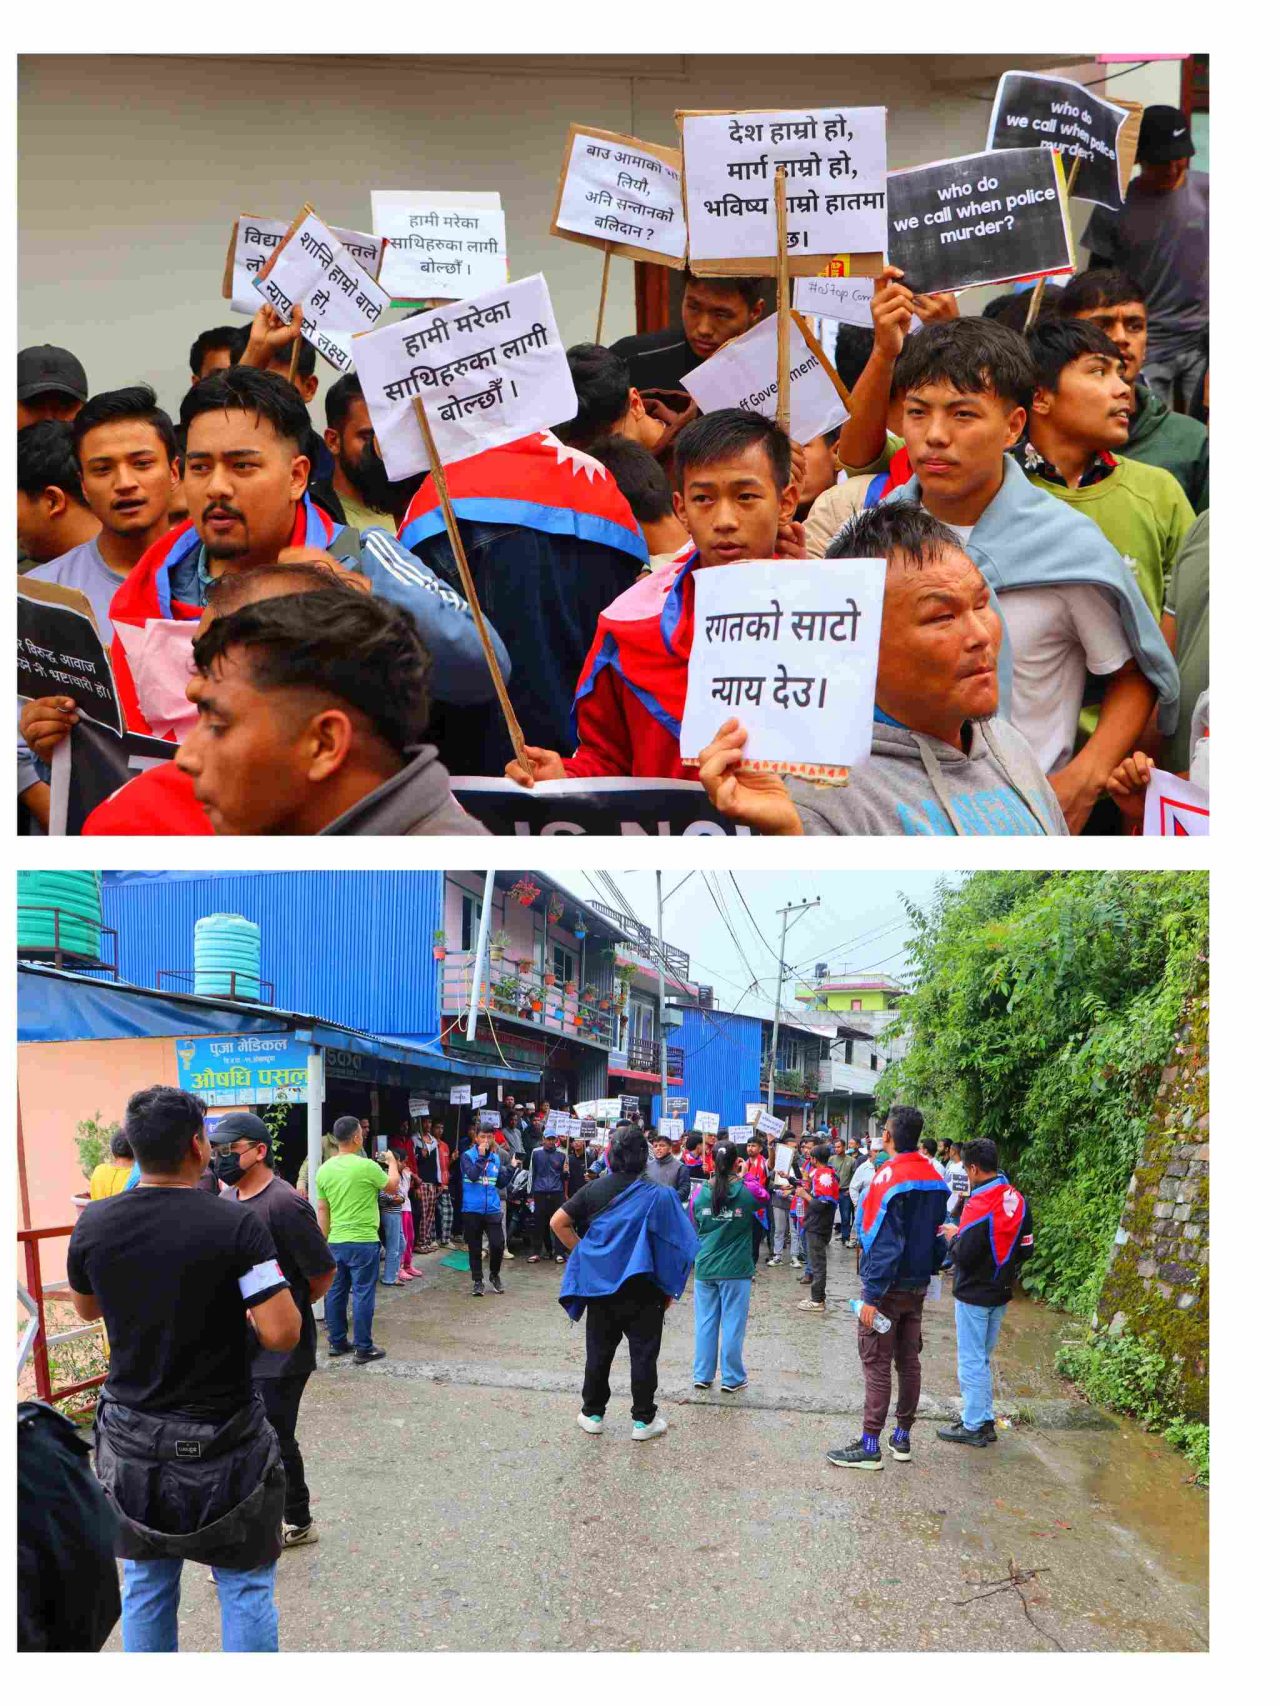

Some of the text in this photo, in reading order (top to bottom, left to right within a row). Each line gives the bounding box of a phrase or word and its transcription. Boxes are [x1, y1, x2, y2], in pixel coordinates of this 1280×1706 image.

[1051, 101, 1092, 125] who do
[729, 114, 854, 145] देश हाम्रो हो,
[1006, 115, 1116, 161] we call when police
[586, 144, 611, 160] बाउ
[727, 154, 768, 180] मार्ग
[827, 150, 858, 180] हो,
[937, 176, 999, 201] who do
[585, 190, 674, 223] अनि सन्तानको
[704, 194, 769, 217] भविष्य
[825, 192, 885, 215] हातमा
[893, 188, 1056, 232] we call when police
[409, 211, 479, 229] हामी मरेका
[594, 215, 643, 238] बलिदान
[940, 215, 1015, 244] murder?
[390, 234, 463, 252] साथिहरुका
[466, 237, 499, 253] लागी
[300, 232, 334, 270] शान्ति
[328, 264, 358, 298] हाम्रो
[355, 292, 383, 323] बाटो
[267, 280, 293, 314] न्याय
[310, 289, 331, 316] हो,
[402, 300, 511, 358] हामी मरेका
[382, 322, 548, 401] साथिहरुका लागी
[705, 598, 861, 644] रगतको साटो
[59, 653, 96, 675] आवाज
[711, 664, 827, 709] न्याय देउ।
[237, 1037, 288, 1052] मेडिकल
[190, 1066, 252, 1089] औषधि
